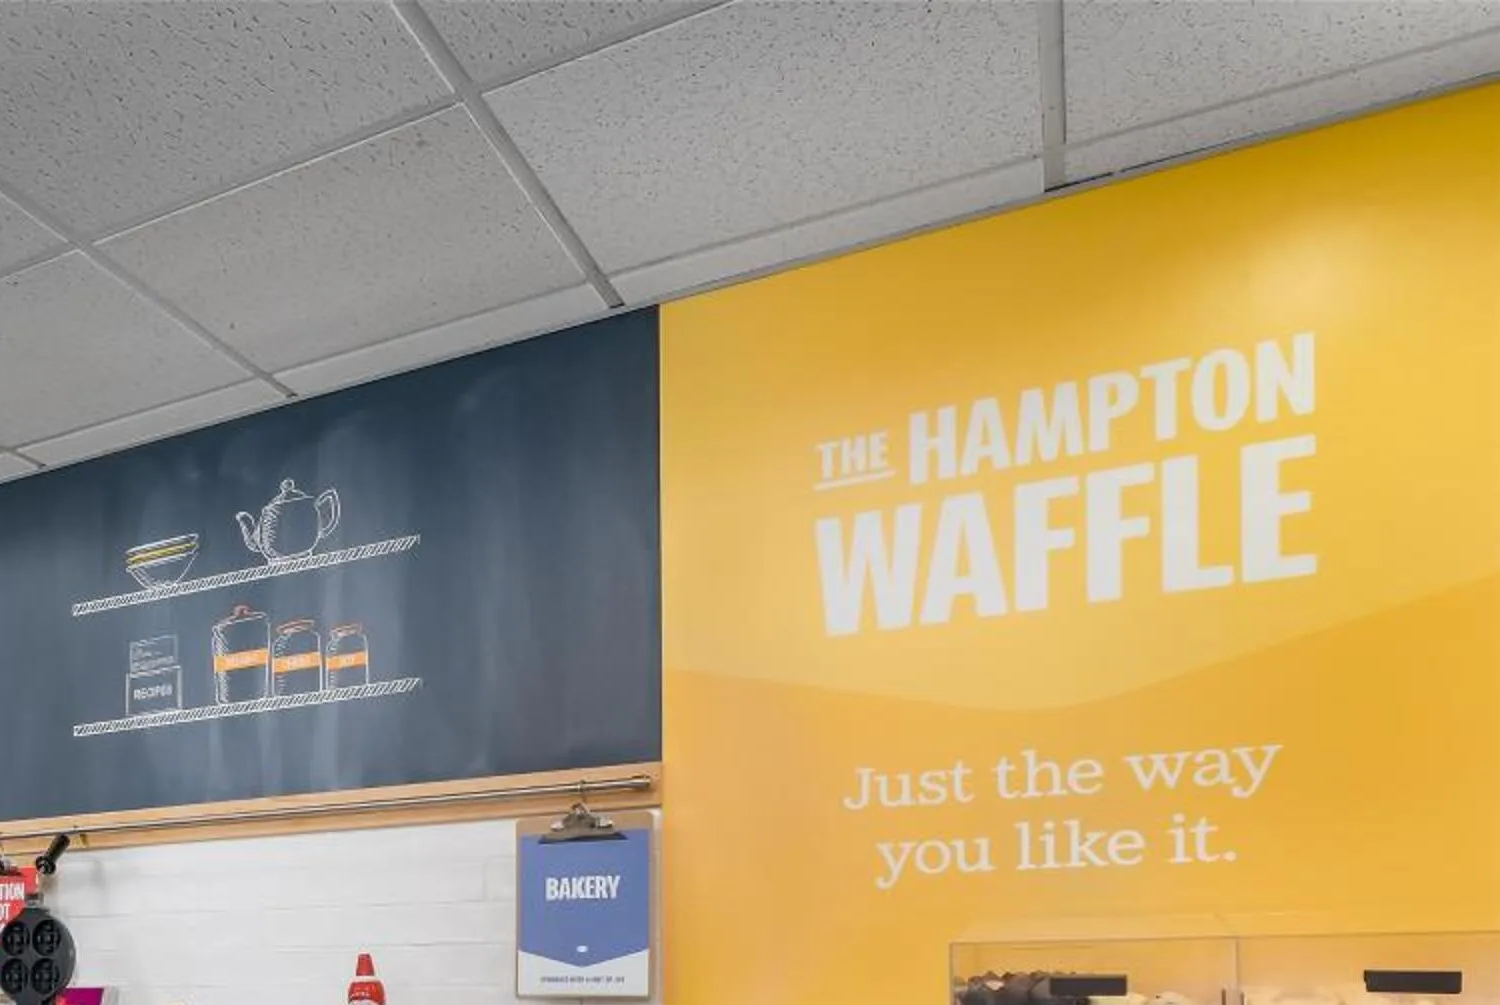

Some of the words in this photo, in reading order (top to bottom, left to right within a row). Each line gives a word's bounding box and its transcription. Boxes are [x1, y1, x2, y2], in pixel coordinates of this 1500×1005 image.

[817, 430, 889, 481] THE
[908, 332, 1316, 486] HAMPTON
[814, 433, 1318, 638] WAFFLE
[843, 759, 974, 810] Just
[991, 748, 1104, 799] the
[1123, 743, 1284, 798] way
[545, 875, 621, 901] BAKERY
[874, 834, 995, 889] you
[1015, 819, 1145, 872] like
[1167, 812, 1238, 865] it.
